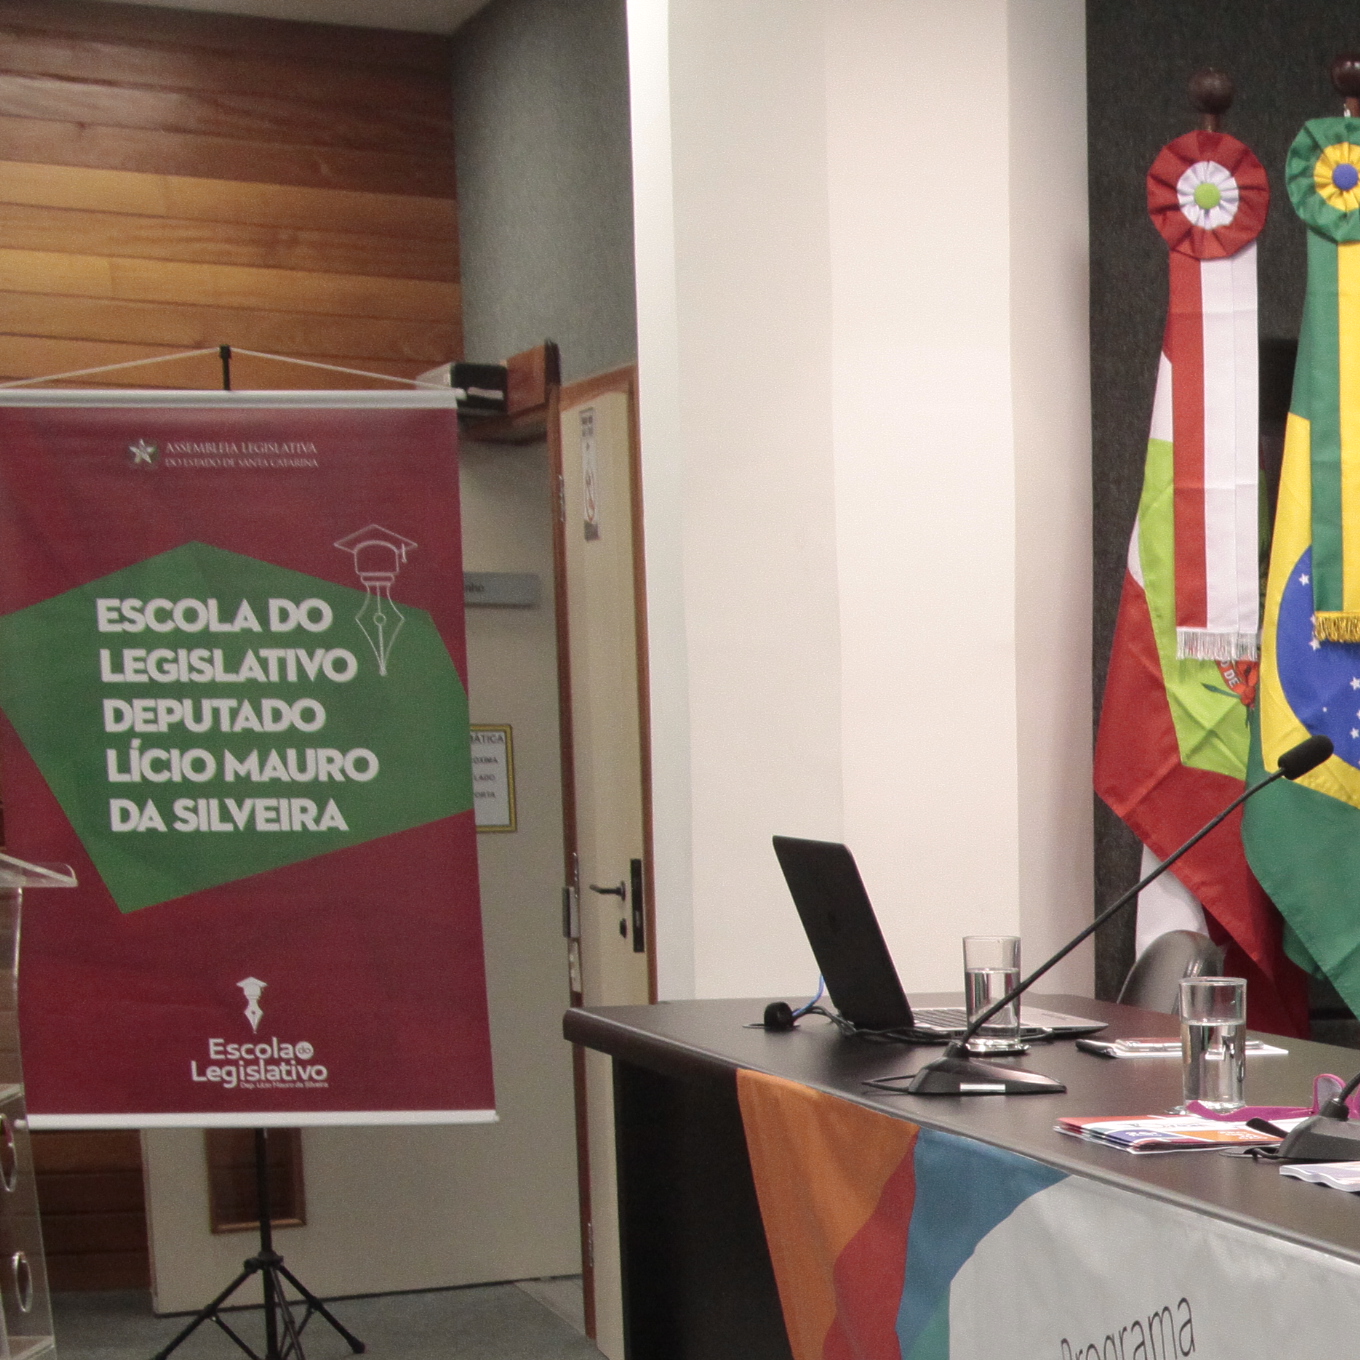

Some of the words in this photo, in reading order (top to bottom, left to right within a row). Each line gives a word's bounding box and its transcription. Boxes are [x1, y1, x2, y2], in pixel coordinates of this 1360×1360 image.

[165, 442, 239, 454] ASSEMBLEIA
[241, 442, 318, 454] LEGISLATIVA
[96, 597, 263, 632] ESCOLA
[268, 597, 334, 632] DO
[100, 648, 358, 683] LEGISLATIVO
[102, 698, 327, 732] DEPUTADO
[106, 738, 217, 782] LÍCIO
[223, 748, 380, 782] MAURO
[109, 798, 168, 832] DA
[172, 798, 350, 832] SILVEIRA
[208, 1036, 295, 1060] Escola
[190, 1059, 328, 1088] Legislativo
